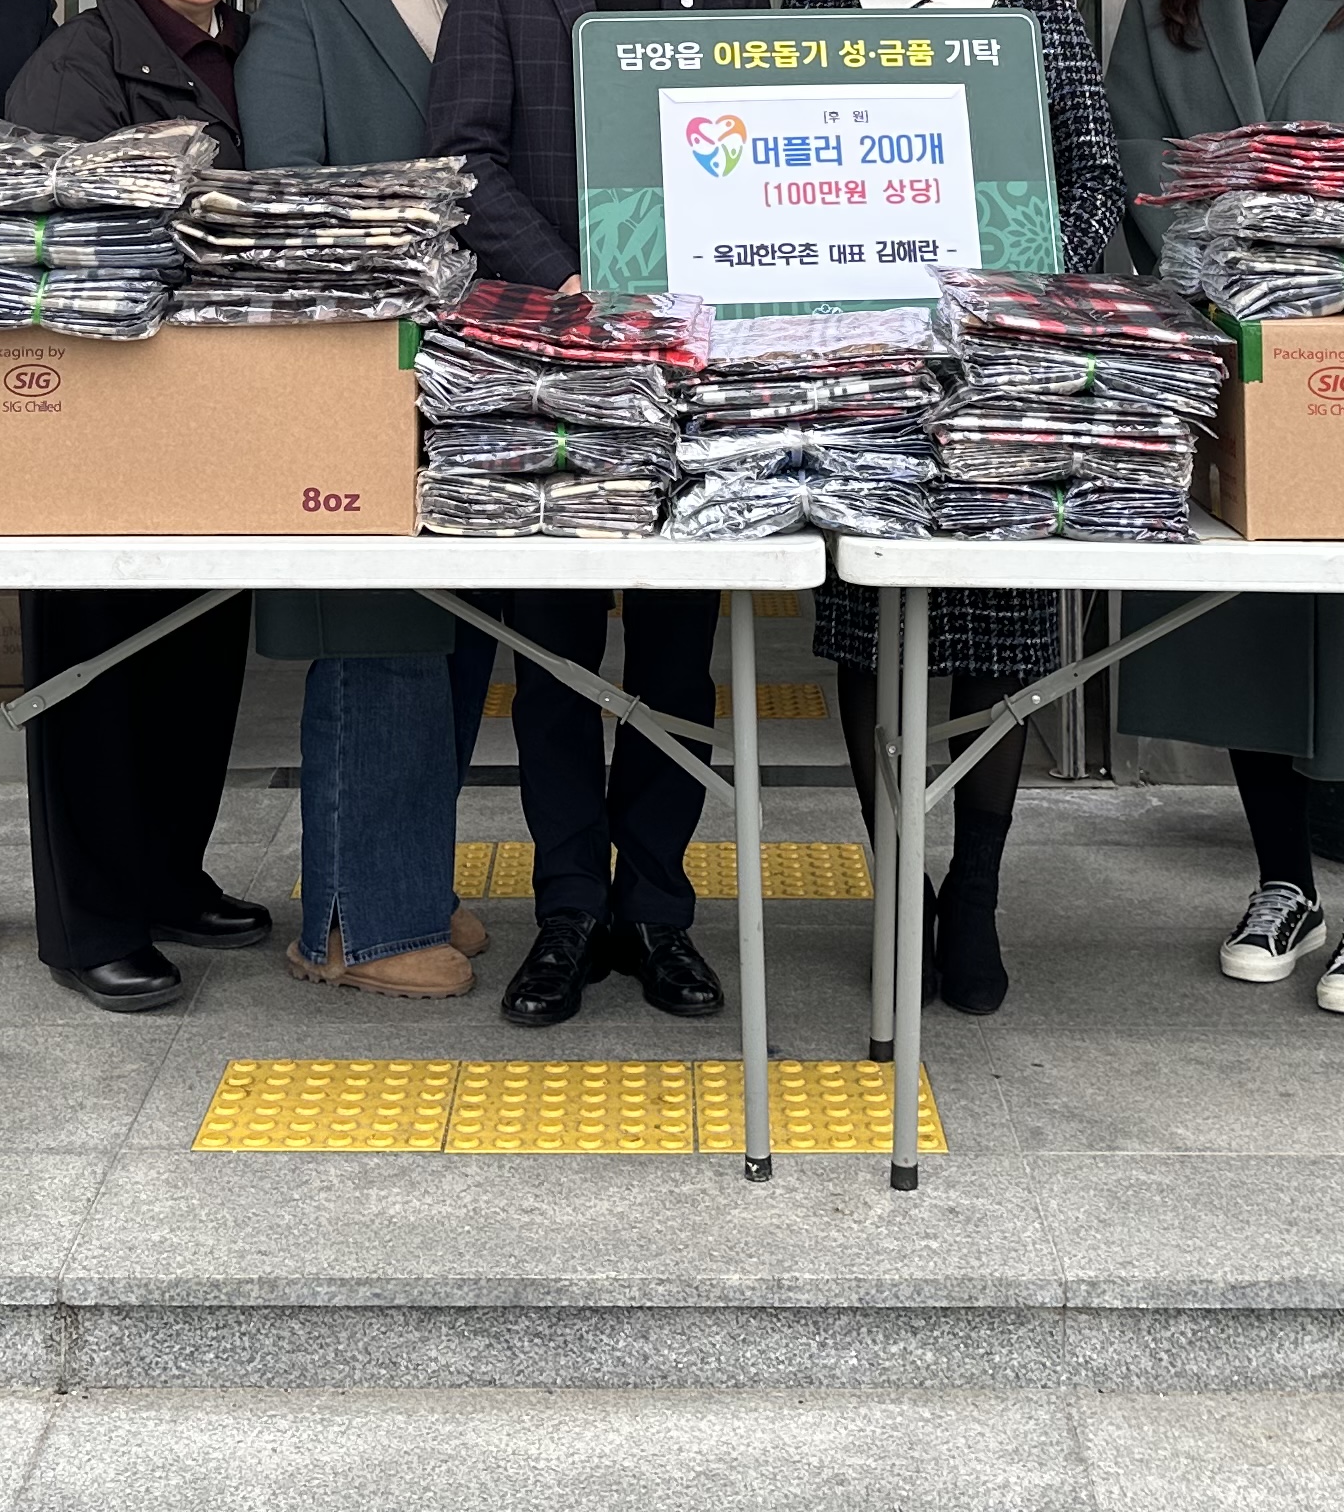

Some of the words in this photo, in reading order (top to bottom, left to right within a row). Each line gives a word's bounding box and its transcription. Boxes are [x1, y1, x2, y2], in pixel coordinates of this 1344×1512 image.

[616, 42, 703, 71] 담양읍
[713, 40, 828, 70] 이웃돕기
[838, 39, 935, 69] 성·금품
[944, 38, 1001, 67] 기탁
[751, 135, 844, 168] 머플러
[859, 133, 945, 166] 200개
[713, 243, 820, 268] 옥과한우촌
[829, 242, 866, 266] 대표
[875, 239, 941, 264] 김해란
[47, 345, 66, 362] by
[13, 371, 53, 391] SIG
[2, 401, 21, 413] SIG
[24, 400, 62, 413] Chilled
[1307, 404, 1326, 416] SIG
[301, 488, 362, 512] 8oz
